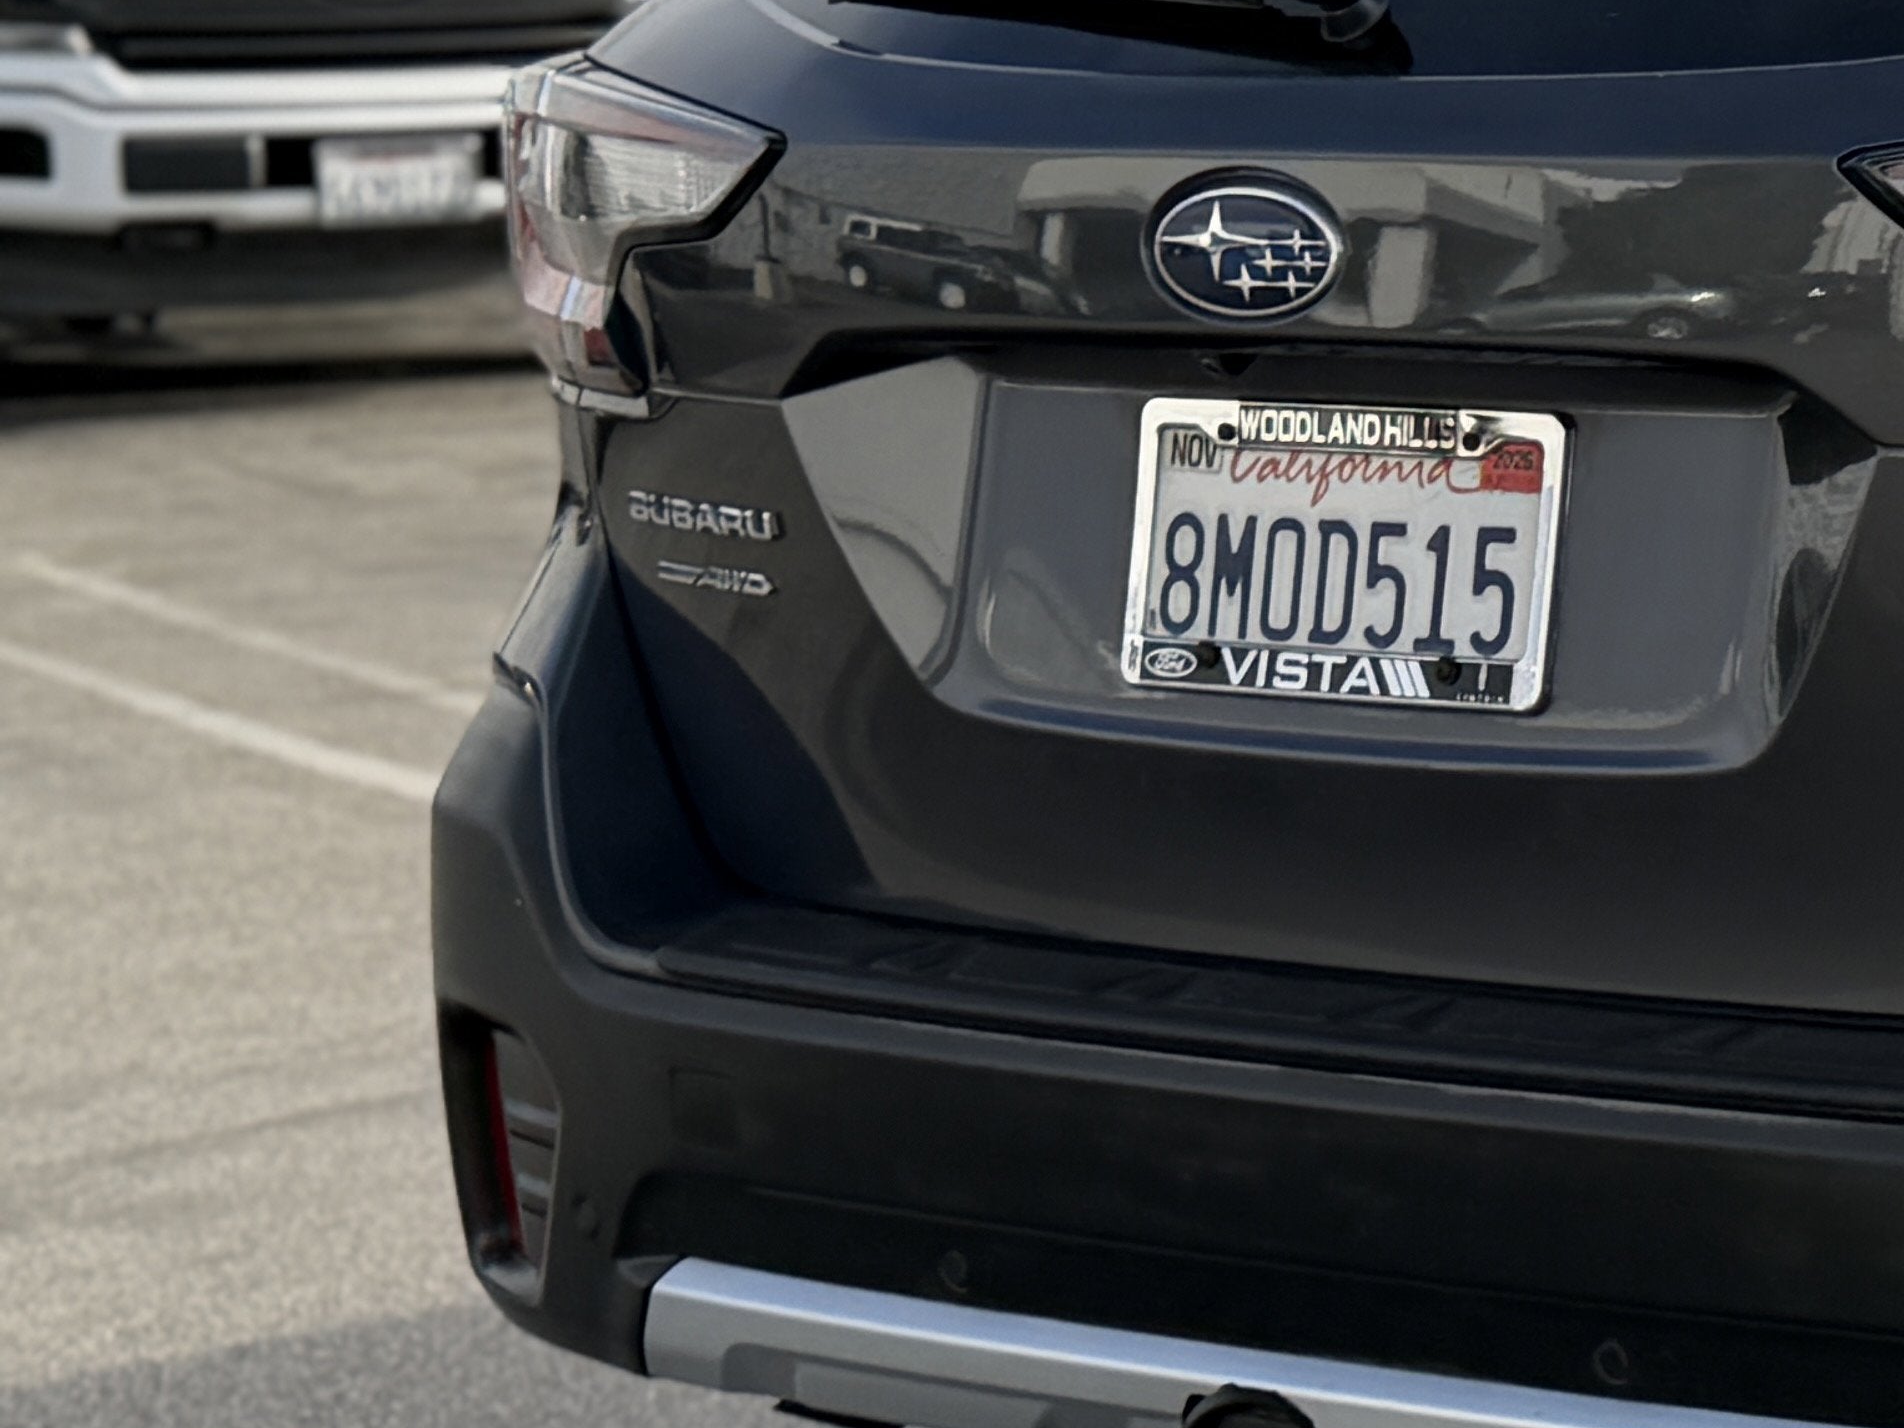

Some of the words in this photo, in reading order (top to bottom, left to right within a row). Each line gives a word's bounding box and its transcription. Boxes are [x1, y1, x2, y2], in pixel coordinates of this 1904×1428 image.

[1171, 433, 1218, 468] NOV
[1240, 409, 1381, 445] WOODLAND
[1383, 414, 1457, 449] HILLS
[1230, 448, 1474, 507] California
[628, 490, 776, 541] SUBARU
[1159, 511, 1518, 656] 8MOD515
[1221, 646, 1382, 696] VISTA
